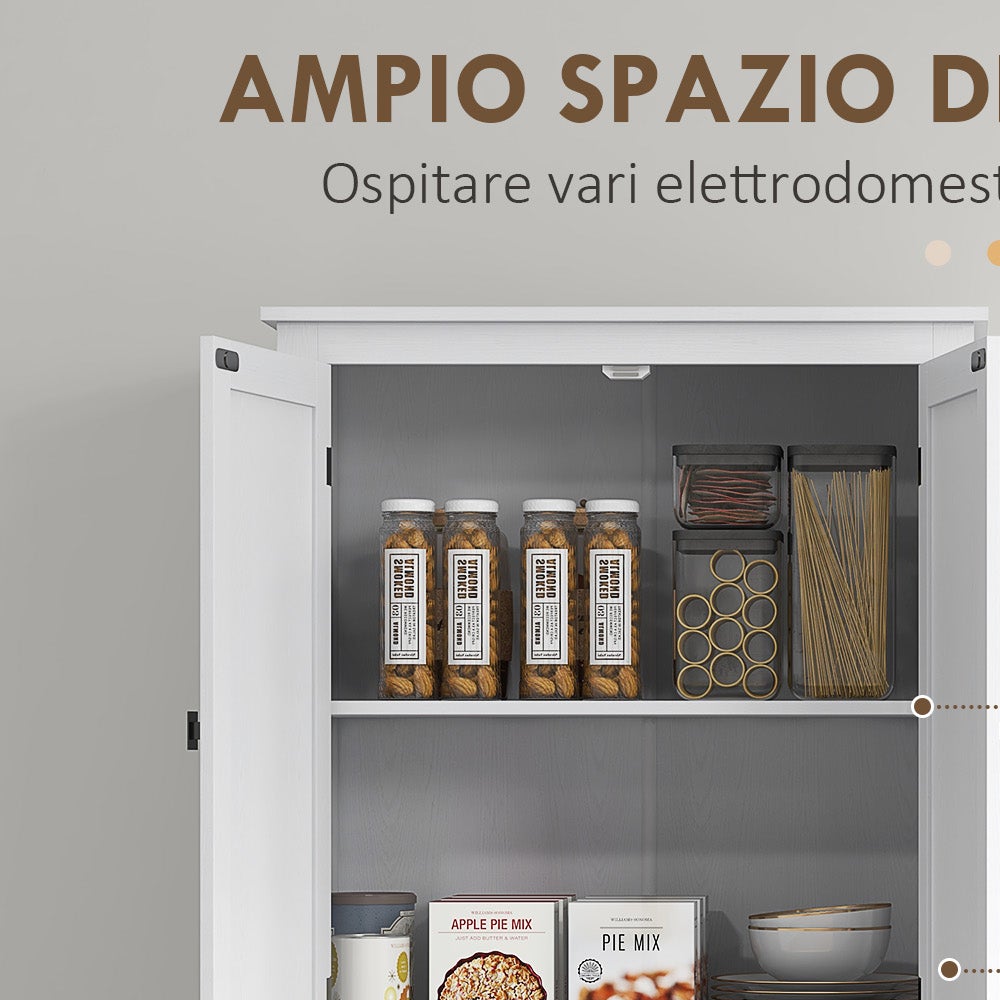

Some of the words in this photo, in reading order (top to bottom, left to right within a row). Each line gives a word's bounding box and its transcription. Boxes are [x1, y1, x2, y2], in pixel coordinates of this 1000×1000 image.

[451, 918, 487, 930] APPLE
[490, 918, 508, 930] PIE
[511, 918, 532, 930] MIX
[602, 933, 626, 951] PIE
[634, 933, 660, 951] MIX
